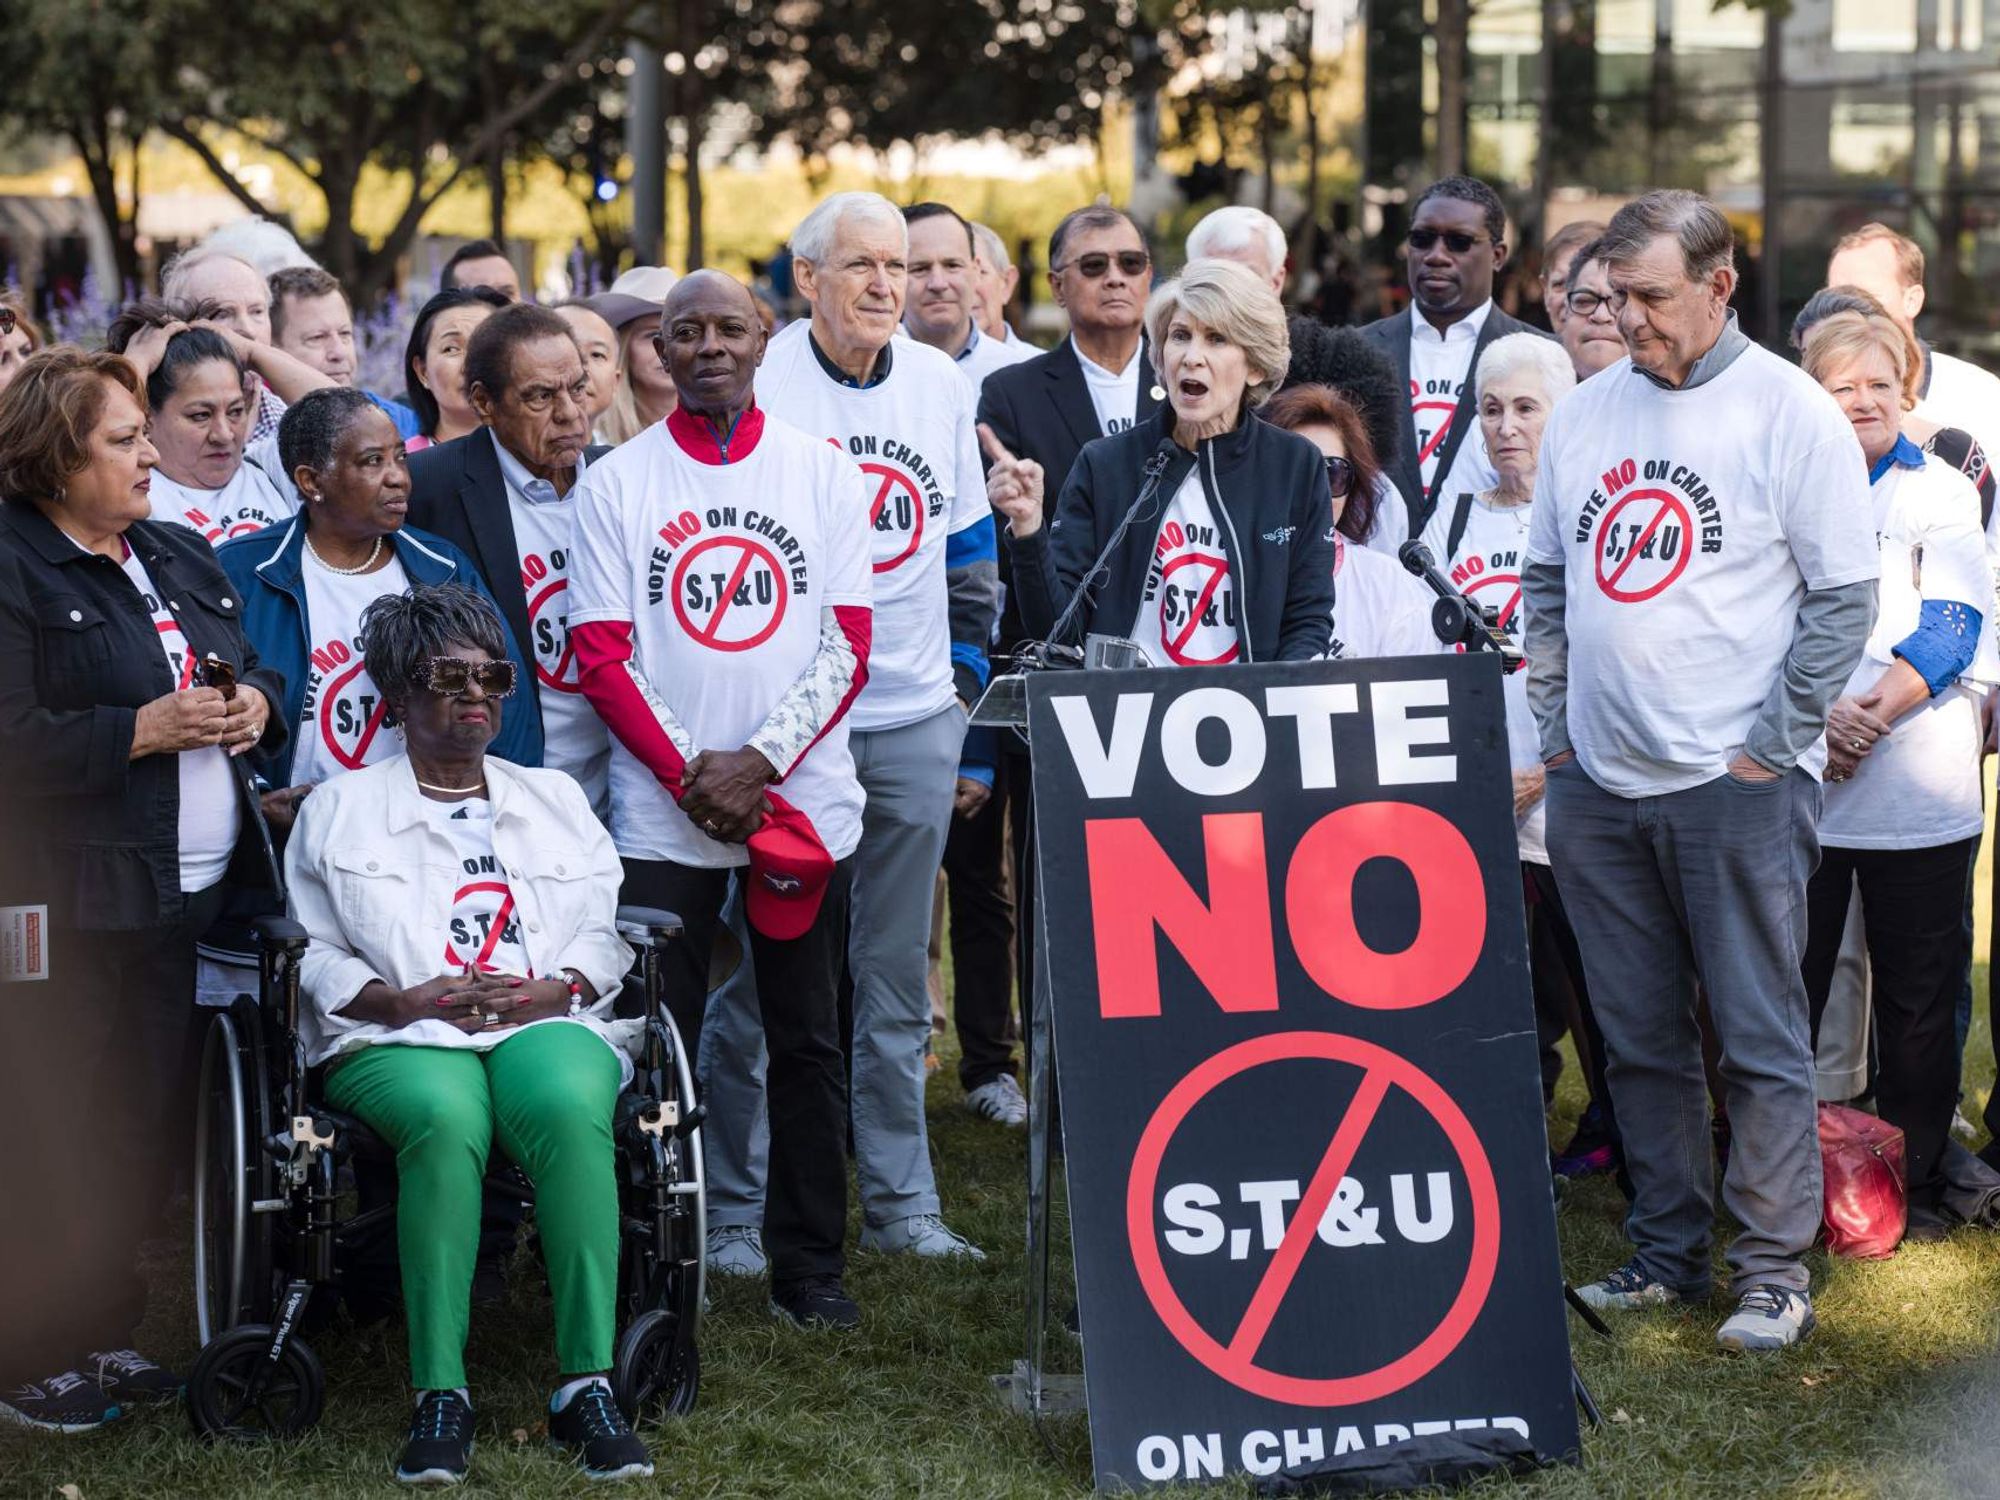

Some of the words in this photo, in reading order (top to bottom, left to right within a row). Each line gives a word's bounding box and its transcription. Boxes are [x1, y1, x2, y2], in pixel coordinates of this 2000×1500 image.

[1426, 379, 1451, 395] ON
[849, 435, 877, 455] ON
[882, 439, 944, 518] CHARTER
[706, 506, 737, 528] ON
[1576, 489, 1607, 543] VOTE
[1602, 458, 1637, 497] NO
[1644, 460, 1670, 480] ON
[1670, 466, 1723, 553] CHARTER
[658, 510, 702, 549] NO
[1186, 523, 1213, 547] ON
[743, 510, 807, 595] CHARTER
[1451, 556, 1485, 586] NO
[1491, 551, 1518, 568] ON
[647, 547, 672, 606] VOTE
[310, 639, 350, 675] NO
[1050, 679, 1458, 799] VOTE
[463, 855, 496, 876] ON
[1085, 801, 1487, 1018] NO
[285, 1293, 303, 1320] Viper
[1136, 1433, 1224, 1481] ON
